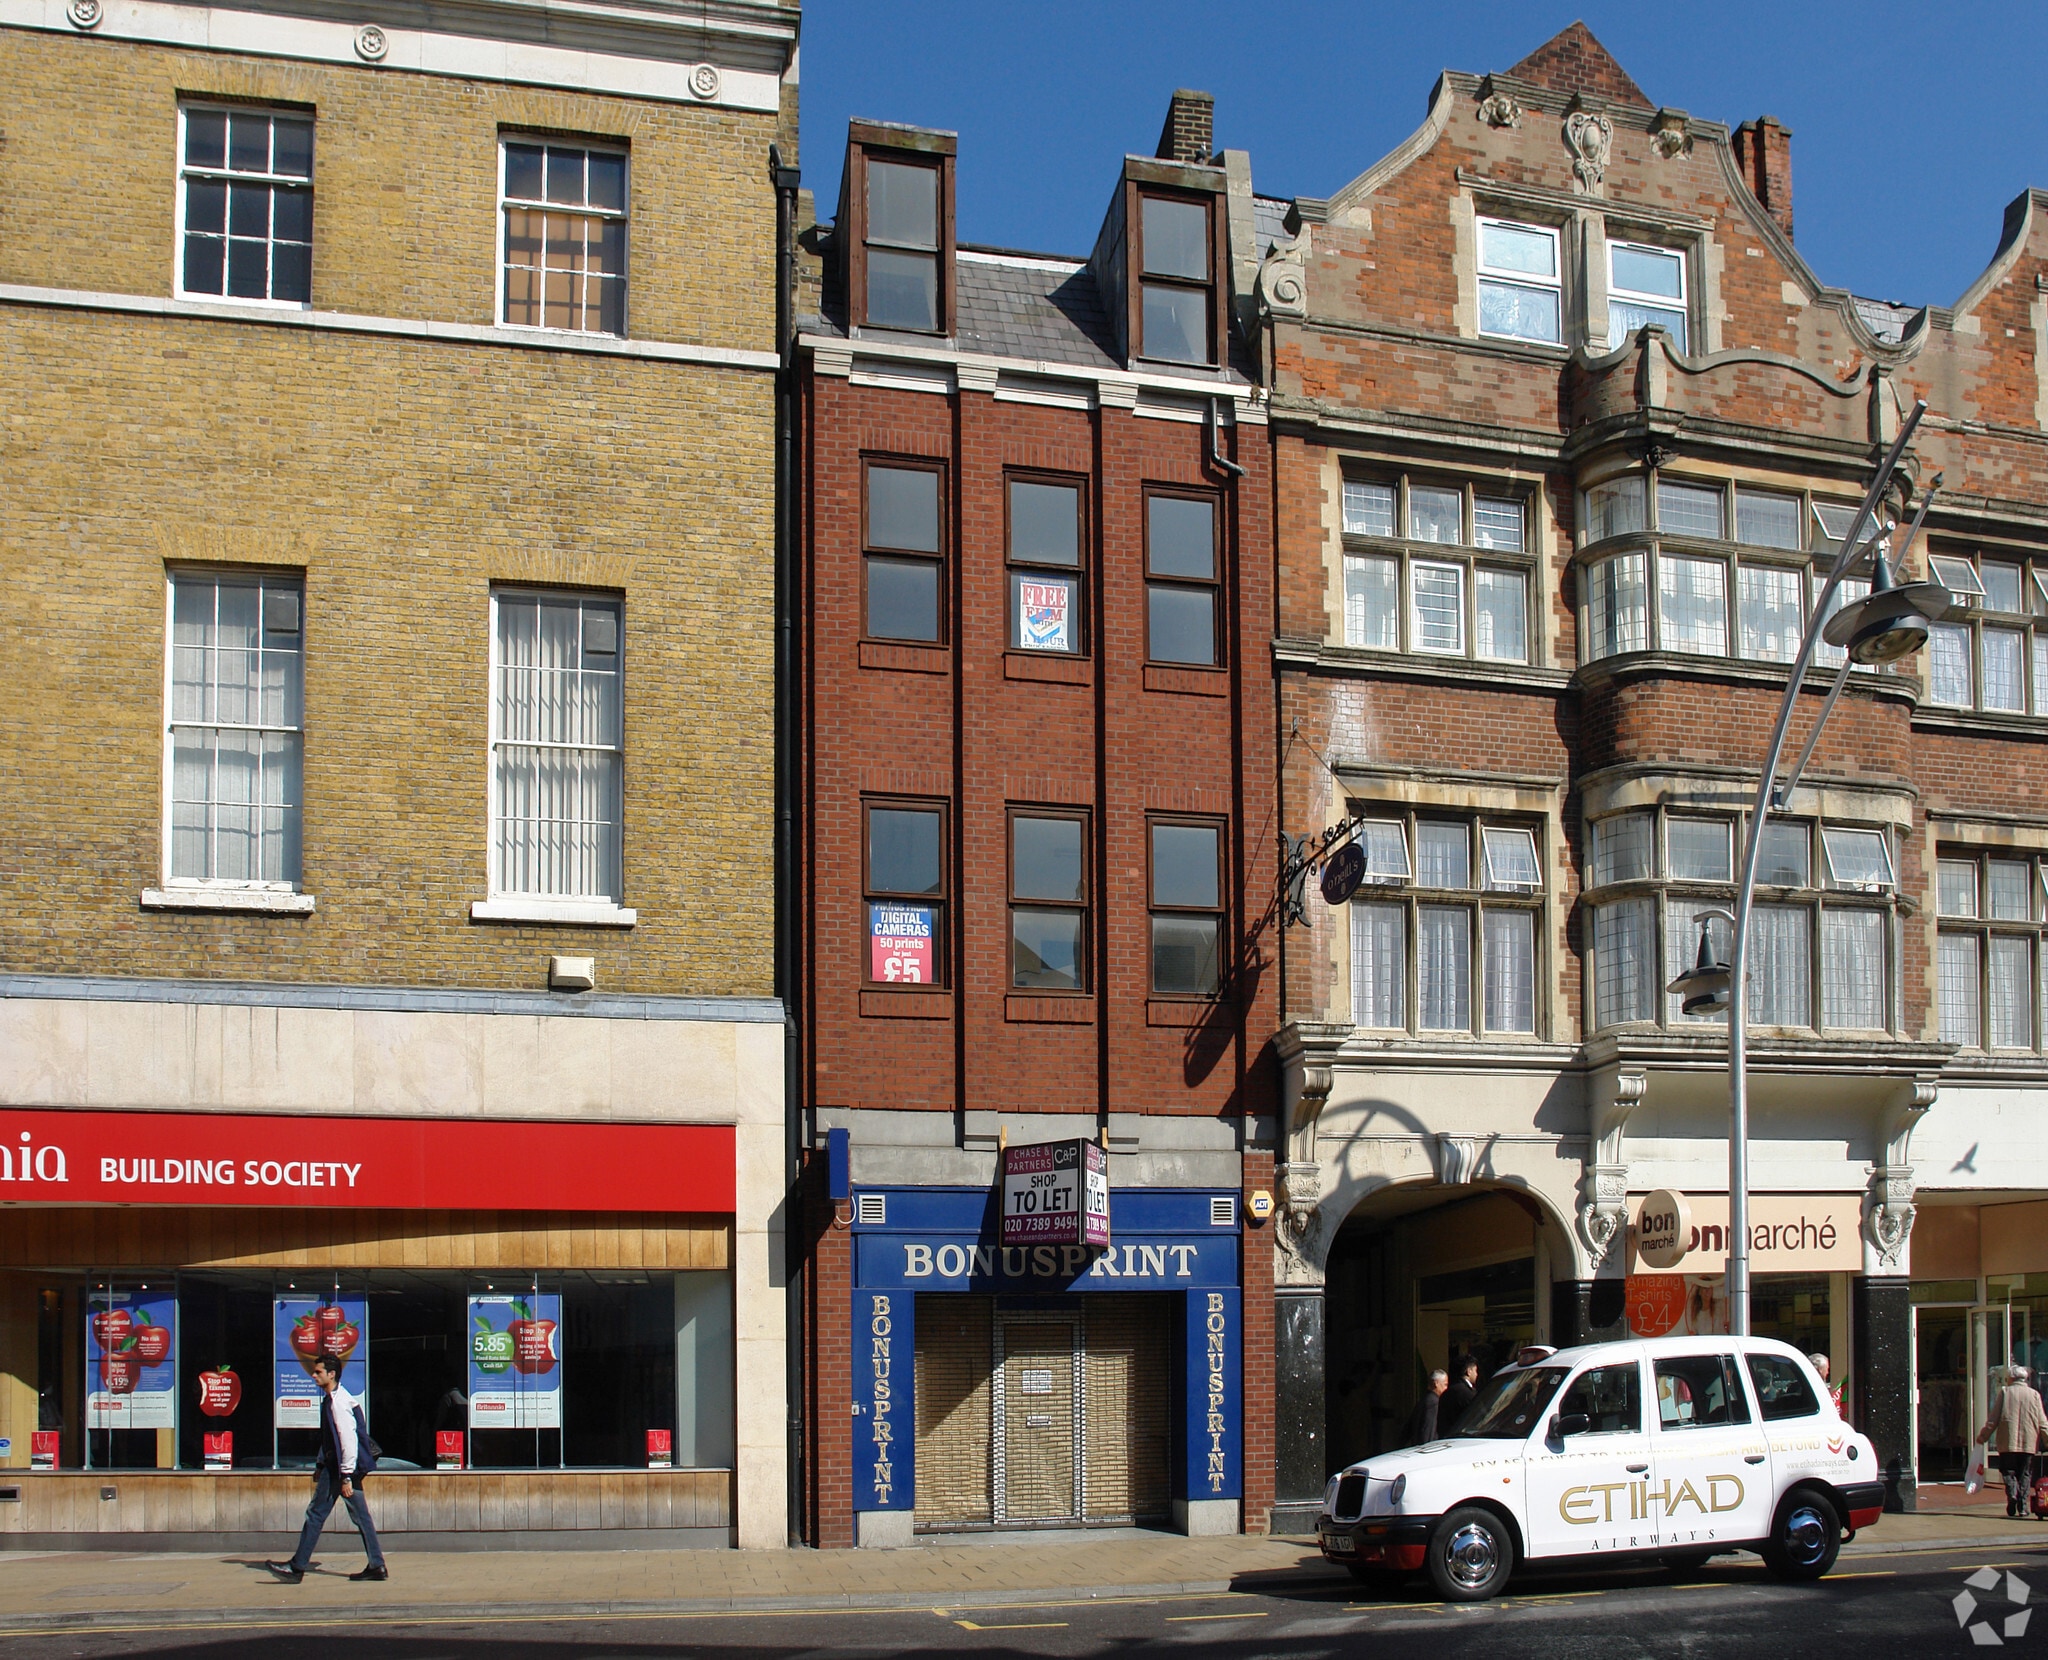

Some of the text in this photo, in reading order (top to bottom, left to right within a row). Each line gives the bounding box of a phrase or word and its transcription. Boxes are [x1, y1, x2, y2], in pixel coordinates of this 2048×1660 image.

[1022, 584, 1066, 608] FREE
[1026, 606, 1063, 621] FILM
[881, 911, 923, 924] DIGITAL
[875, 923, 929, 936] CAMERAS
[880, 938, 924, 949] 50 prints
[884, 957, 921, 982] £5
[1014, 1145, 1051, 1159] CHASE &
[1054, 1147, 1077, 1164] C&P
[100, 1157, 235, 1184] BUILDING
[244, 1160, 362, 1187] SOCIETY
[1008, 1158, 1051, 1172] PARTNERS
[1031, 1174, 1057, 1188] SHOP
[1013, 1187, 1072, 1213] TO LET
[1094, 1191, 1105, 1214] LET
[1255, 1200, 1268, 1209] ADT
[1005, 1219, 1022, 1232] 020
[1025, 1217, 1051, 1231] 7389
[1054, 1215, 1078, 1229] 9494
[1642, 1211, 1674, 1234] bon
[1641, 1233, 1675, 1251] marché
[1687, 1215, 1836, 1253] onarché
[903, 1244, 1198, 1277] BONUSPRINT
[1626, 1276, 1680, 1290] Amazing
[1627, 1288, 1672, 1301] T-shirts
[1638, 1302, 1671, 1333] £4
[474, 1336, 512, 1352] 5.85%
[208, 1378, 220, 1386] Stop
[872, 1296, 893, 1504] BONUSPRINT
[1207, 1293, 1226, 1492] BONUSPRINT
[1559, 1474, 1745, 1525] ETIHAD
[1592, 1529, 1715, 1550] AIRWAYS
